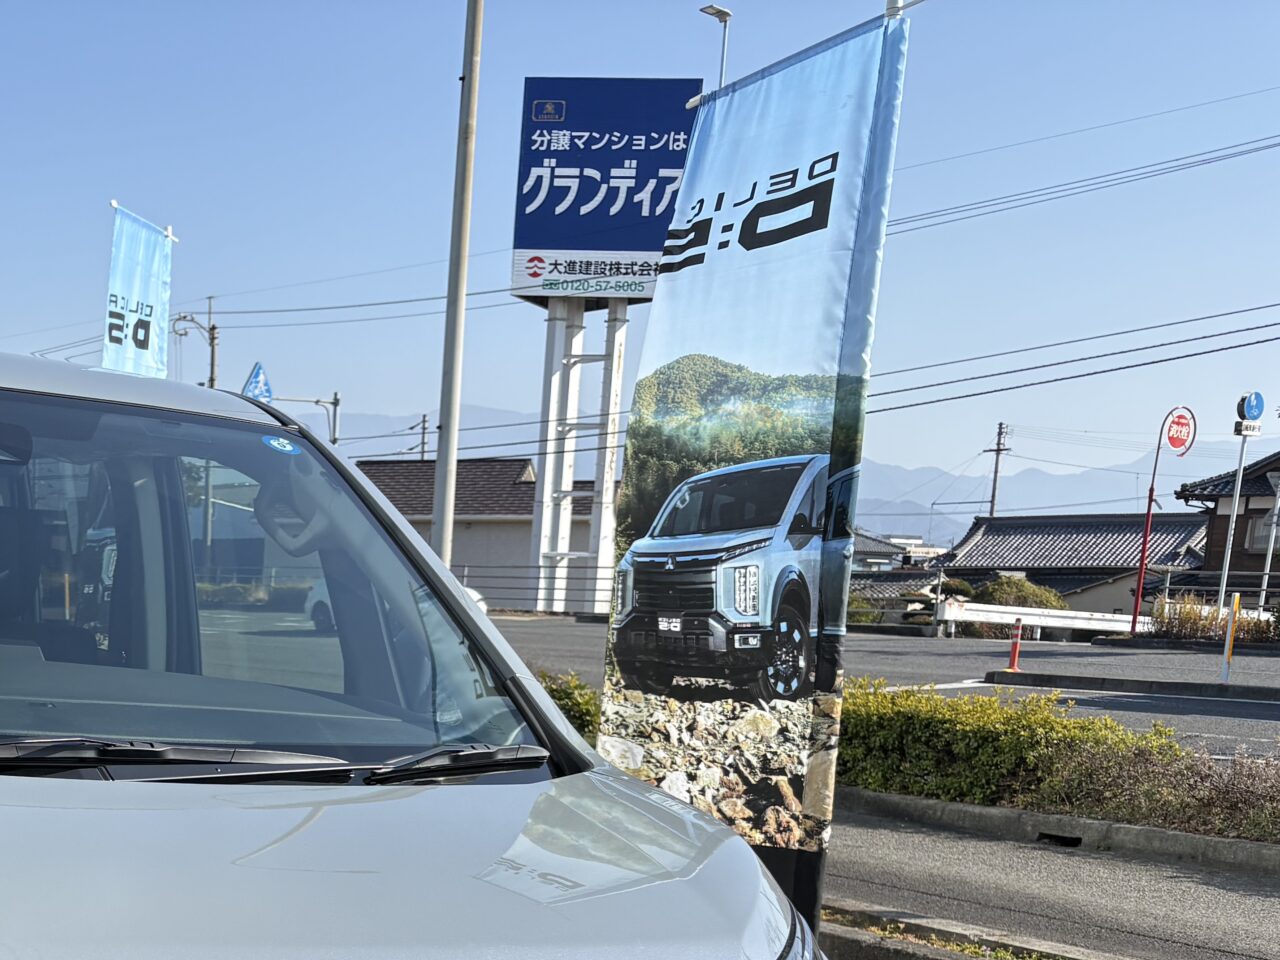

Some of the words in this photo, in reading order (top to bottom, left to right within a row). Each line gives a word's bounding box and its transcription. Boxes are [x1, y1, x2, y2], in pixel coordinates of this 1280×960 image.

[531, 130, 688, 151] 分譲マンションは
[523, 158, 684, 217] グランディア
[561, 280, 645, 292] 0120-57-5005
